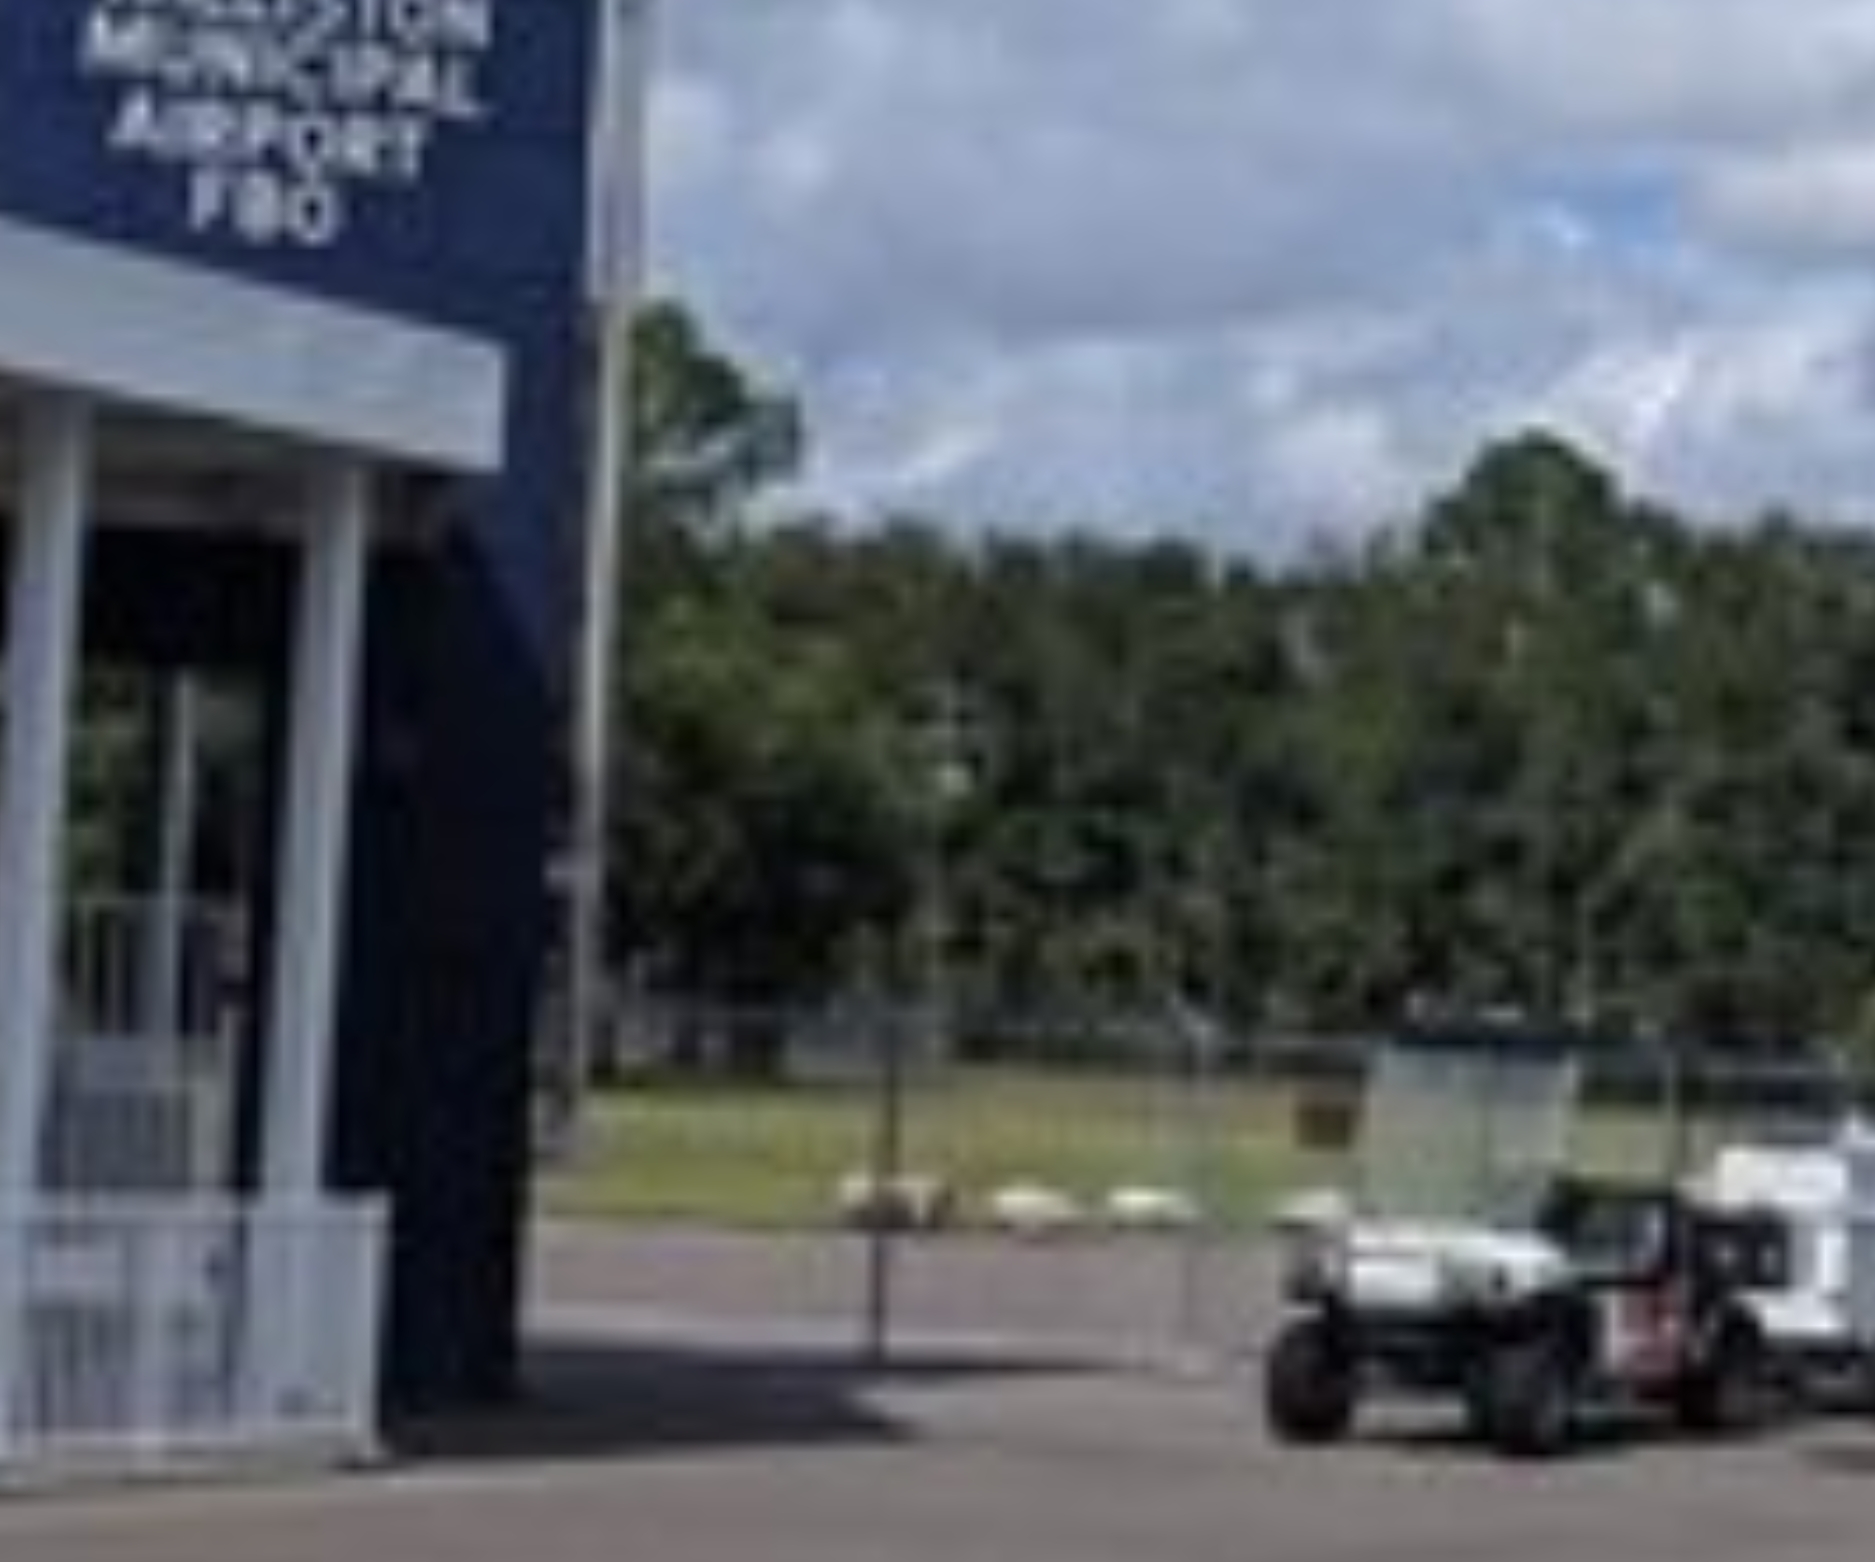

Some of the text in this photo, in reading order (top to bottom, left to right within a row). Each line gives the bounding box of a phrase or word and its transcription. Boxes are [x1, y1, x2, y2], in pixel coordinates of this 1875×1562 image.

[84, 11, 483, 121] MUNICIPAL
[110, 91, 426, 181] AIRPORT
[187, 169, 340, 248] FBO
